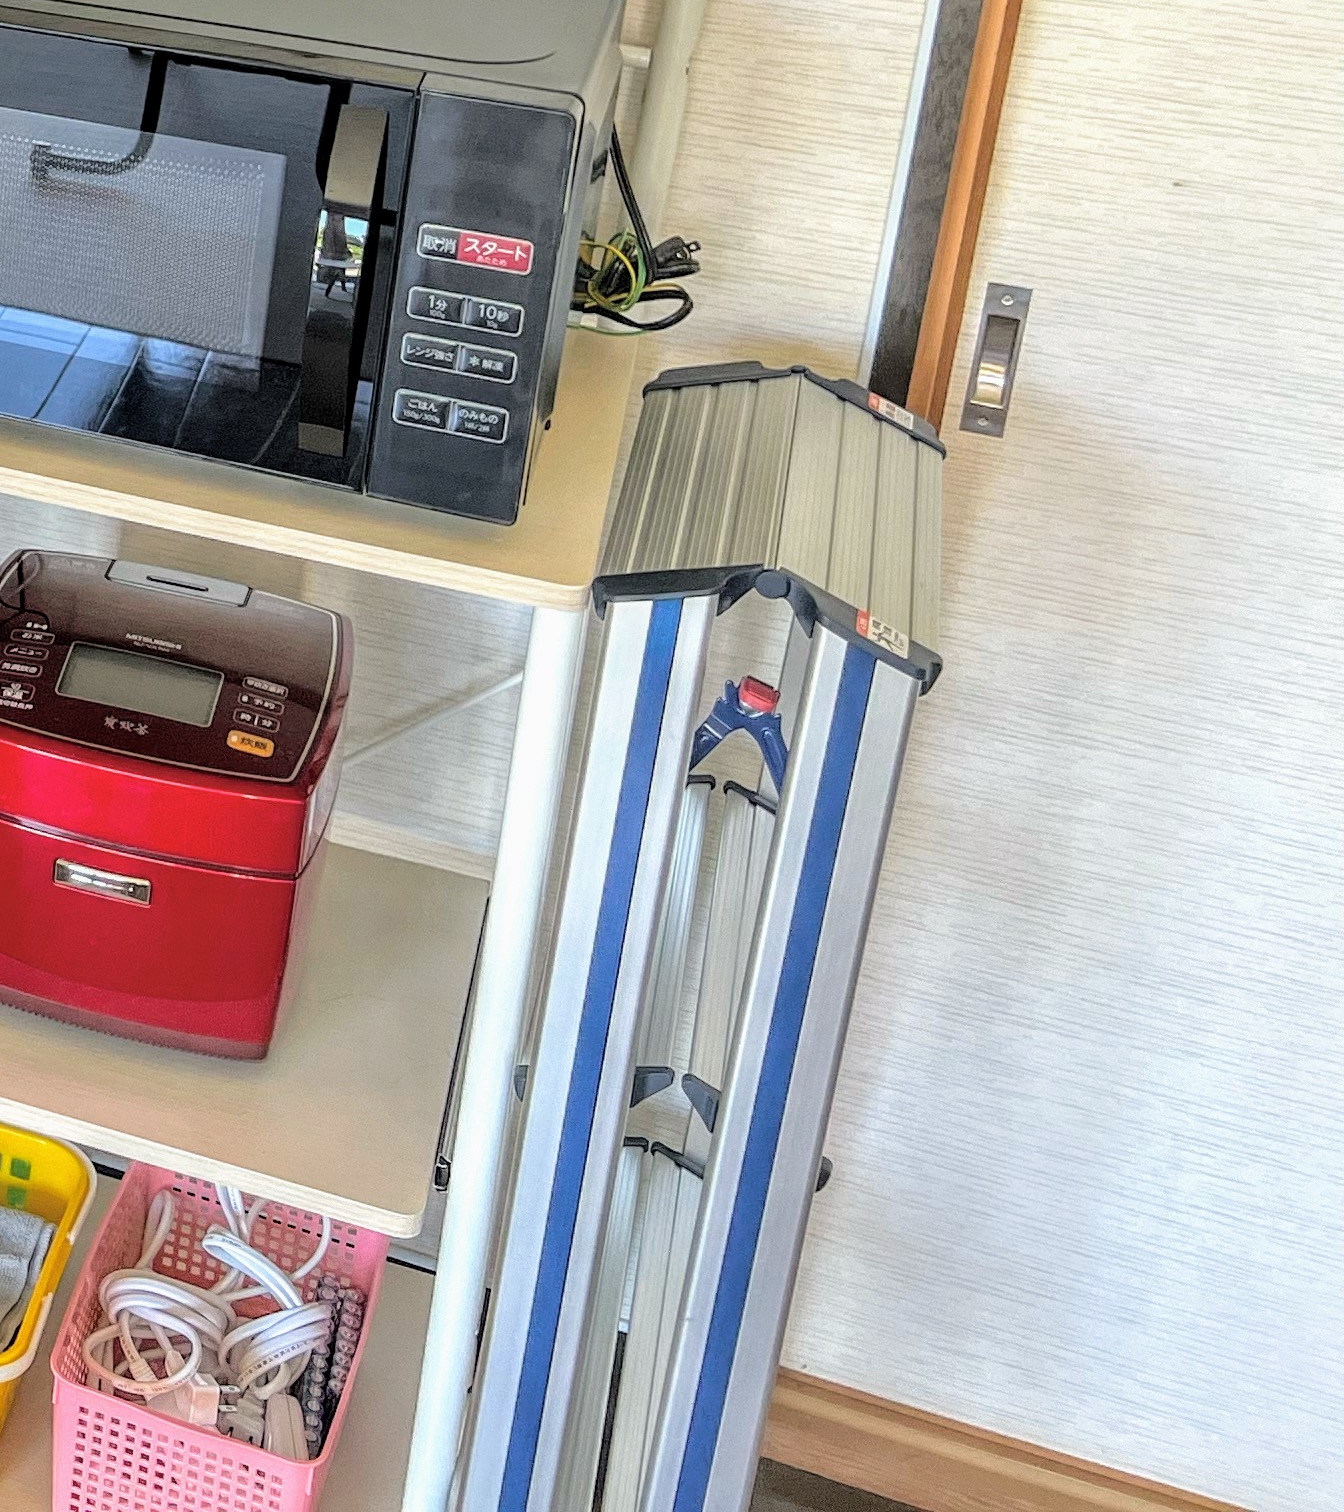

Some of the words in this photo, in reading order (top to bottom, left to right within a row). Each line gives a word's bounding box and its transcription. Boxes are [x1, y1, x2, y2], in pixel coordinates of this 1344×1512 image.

[422, 234, 458, 255] 取消
[463, 237, 528, 262] スタート
[475, 255, 507, 267] あたため
[428, 295, 448, 311] 1分
[478, 304, 510, 322] 10秒
[406, 344, 455, 363] レンジ強さ
[407, 398, 438, 413] ごはん
[458, 408, 499, 424] のみもの
